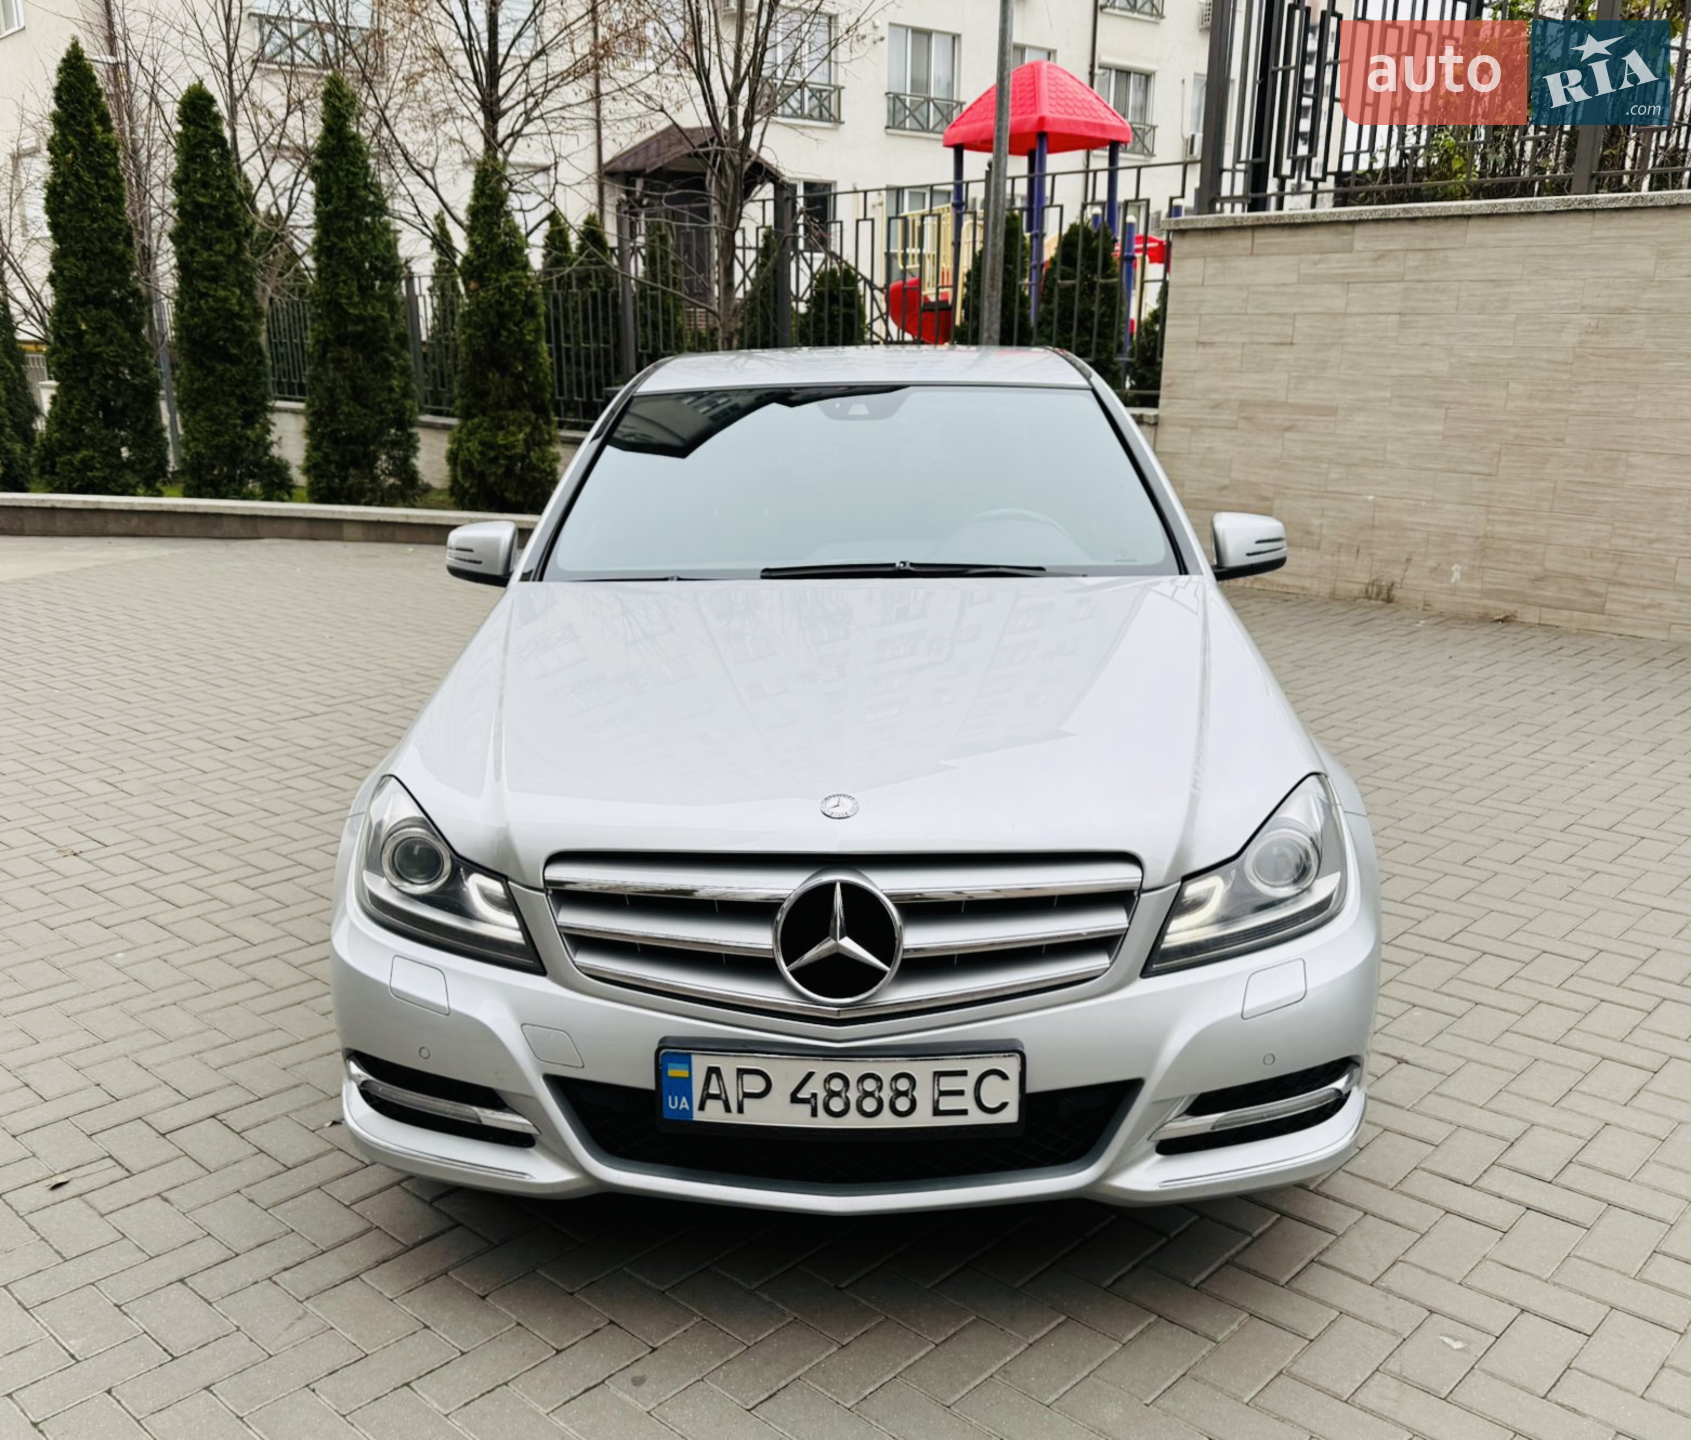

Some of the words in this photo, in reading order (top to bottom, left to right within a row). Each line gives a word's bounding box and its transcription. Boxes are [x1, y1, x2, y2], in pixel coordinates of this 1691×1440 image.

[668, 1095, 689, 1112] UA
[697, 1066, 772, 1114] AP
[789, 1071, 917, 1118] 4888
[932, 1068, 1010, 1116] EC
